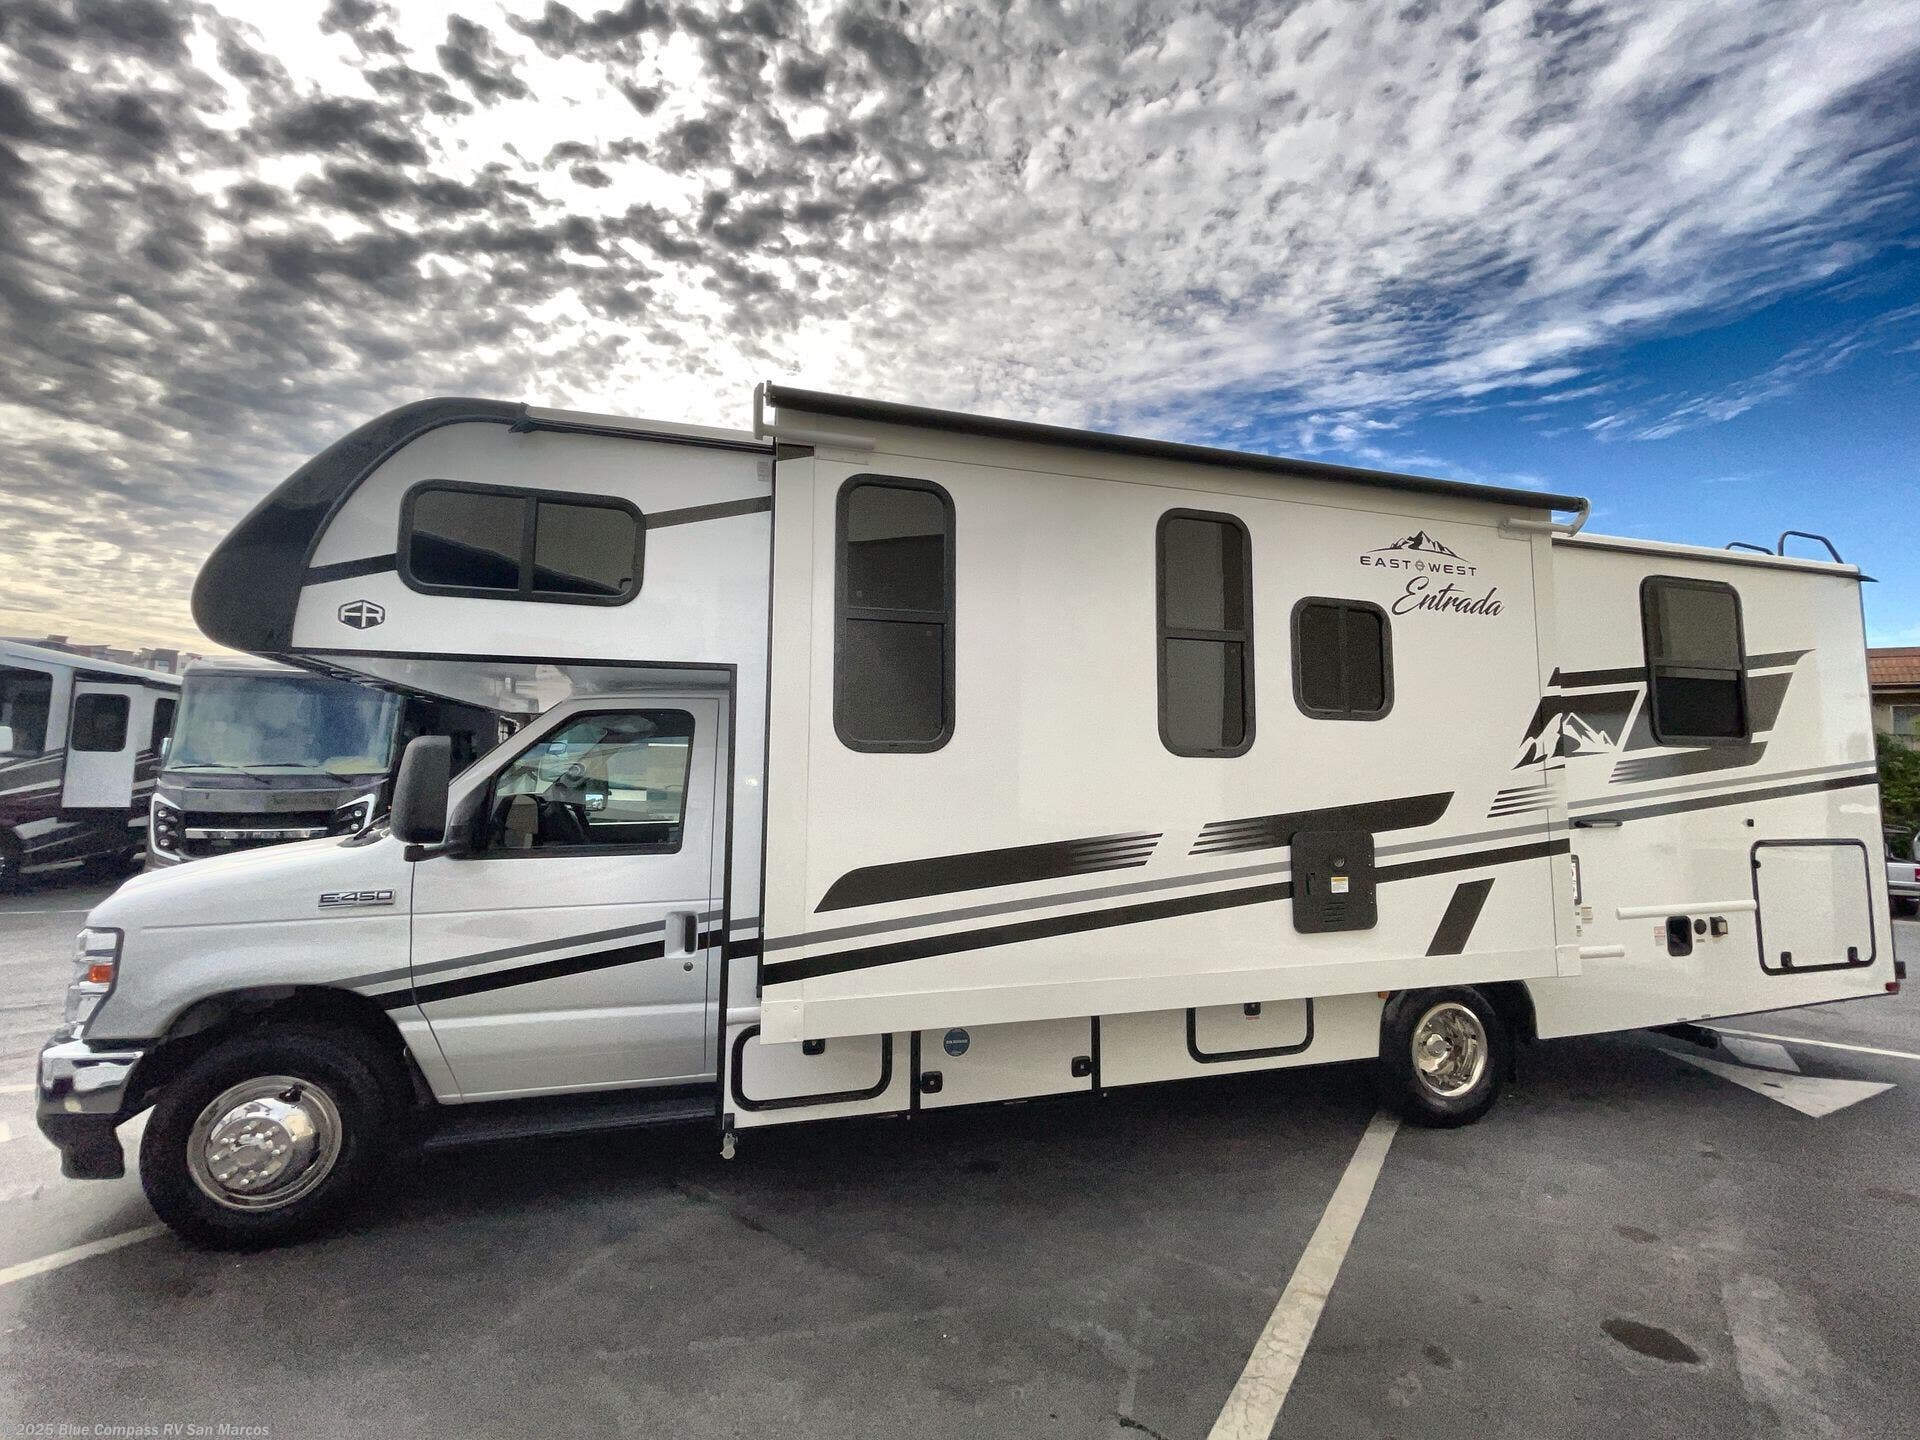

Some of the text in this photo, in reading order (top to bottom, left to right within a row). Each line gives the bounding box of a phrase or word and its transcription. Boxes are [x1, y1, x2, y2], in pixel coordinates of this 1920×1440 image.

[1360, 556, 1477, 576] EAST WEST
[1391, 575, 1505, 616] Entrada
